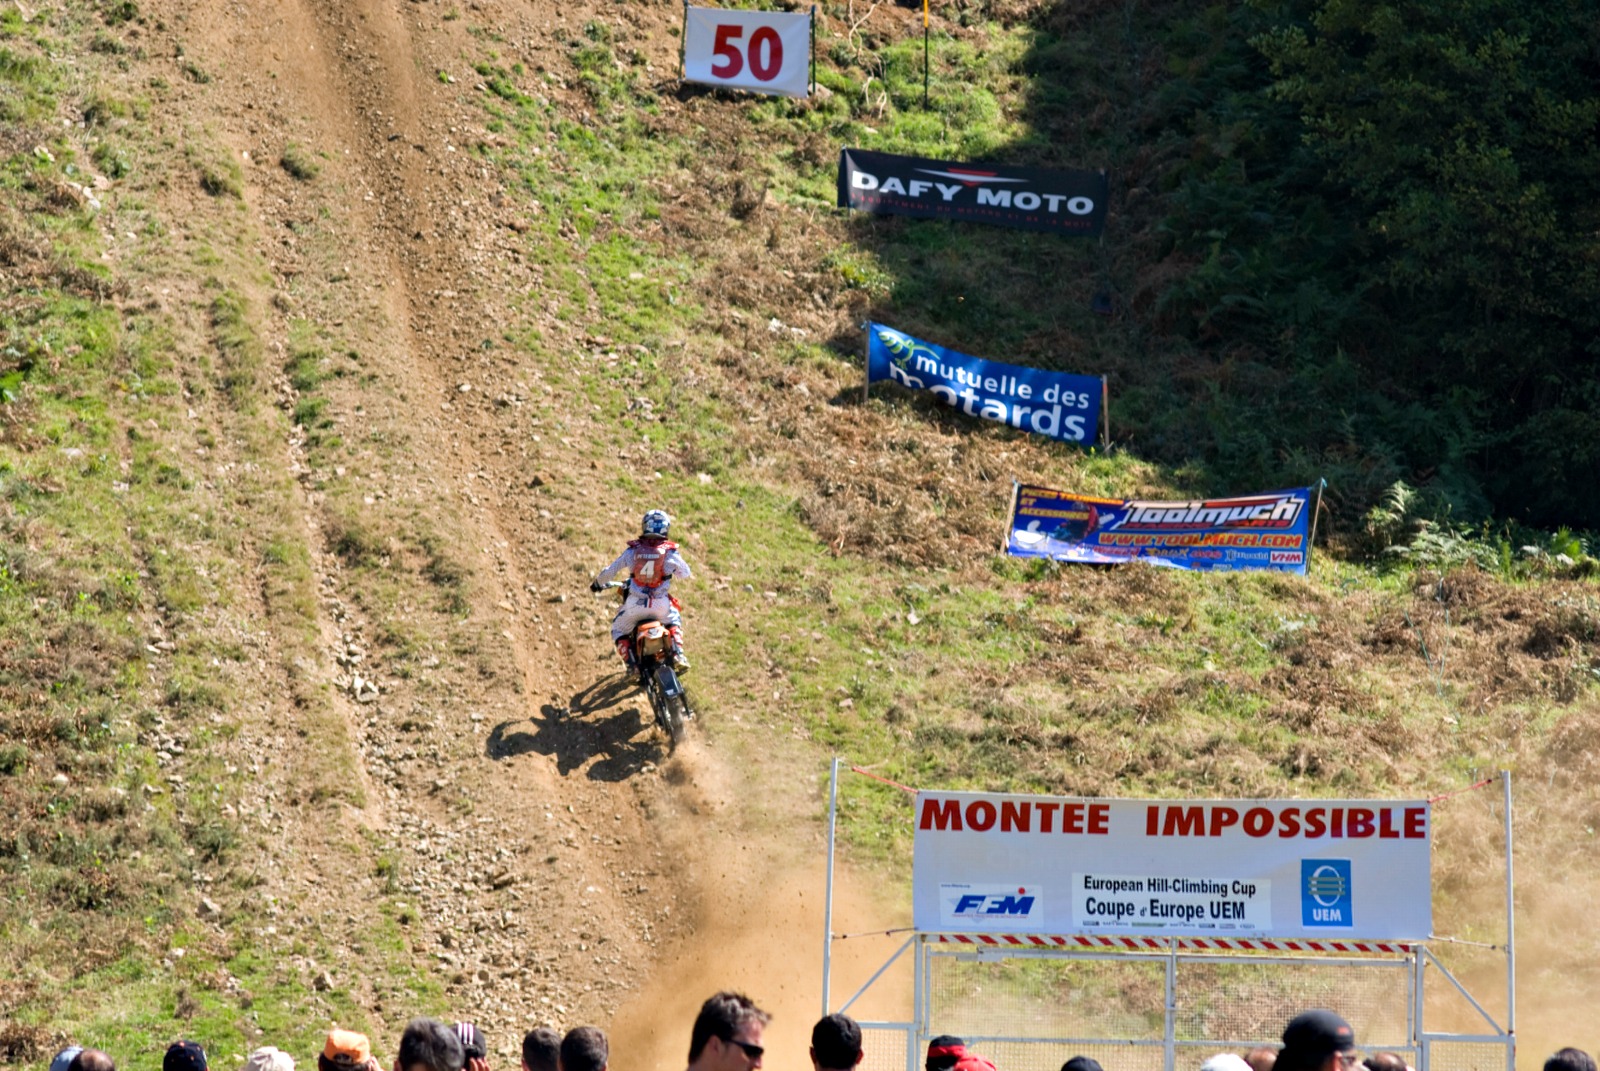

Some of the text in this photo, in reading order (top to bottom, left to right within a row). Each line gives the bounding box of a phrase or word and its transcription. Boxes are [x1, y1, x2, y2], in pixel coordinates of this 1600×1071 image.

[711, 24, 784, 82] 50
[851, 170, 1094, 216] DAFY MOTO
[915, 354, 1090, 410] mutuelle des
[640, 560, 655, 579] 4
[1271, 553, 1302, 563] VHM
[919, 798, 1426, 839] MONTEE IMPOSSIBLE
[1084, 875, 1256, 899] European Hill-Climbing Cup
[1086, 896, 1136, 920] Coupe
[1149, 898, 1205, 922] Europe
[1210, 900, 1246, 920] UEM
[1312, 908, 1342, 922] UEM
